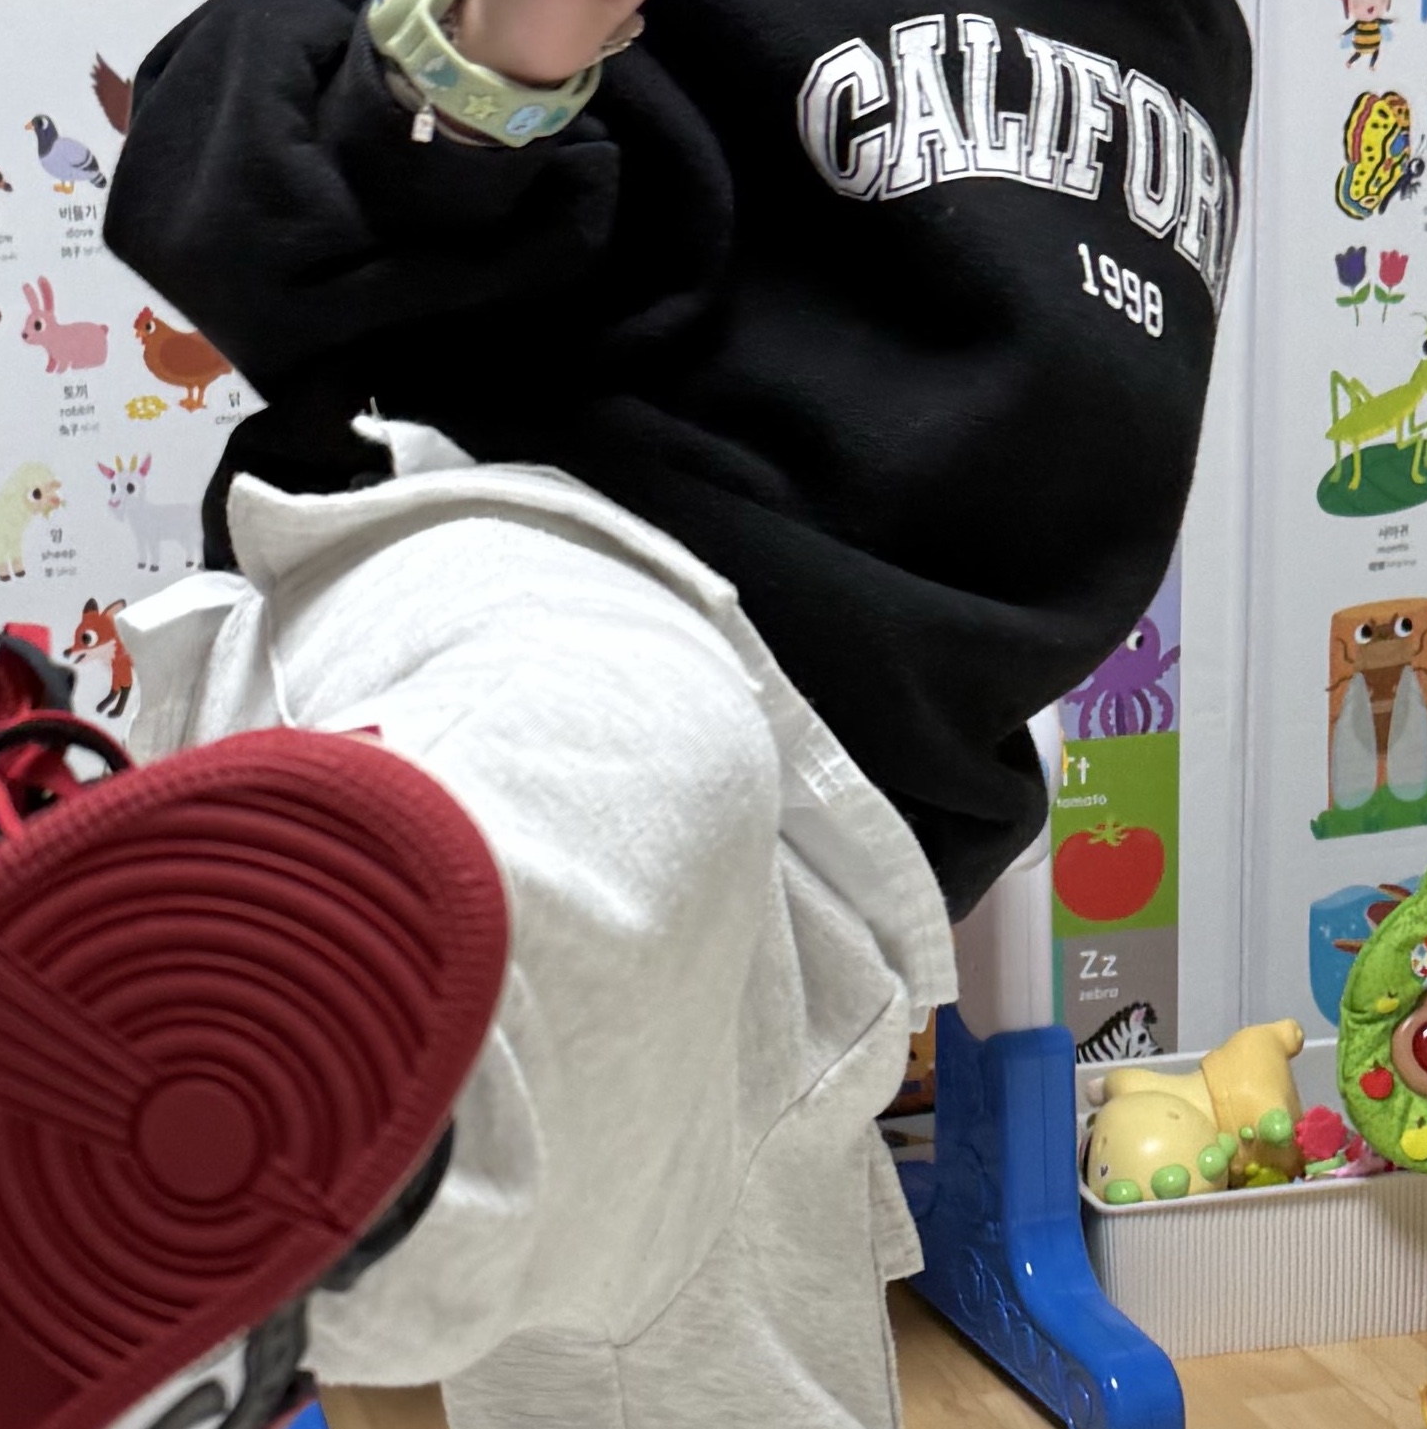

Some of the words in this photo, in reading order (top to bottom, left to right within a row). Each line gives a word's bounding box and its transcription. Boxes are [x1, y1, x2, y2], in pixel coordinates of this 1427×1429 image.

[797, 13, 1236, 316] CALIFOR
[1078, 243, 1164, 338] 1998
[1056, 793, 1108, 809] tomato
[1079, 950, 1119, 980] Zz
[1079, 986, 1119, 1001] zebra
